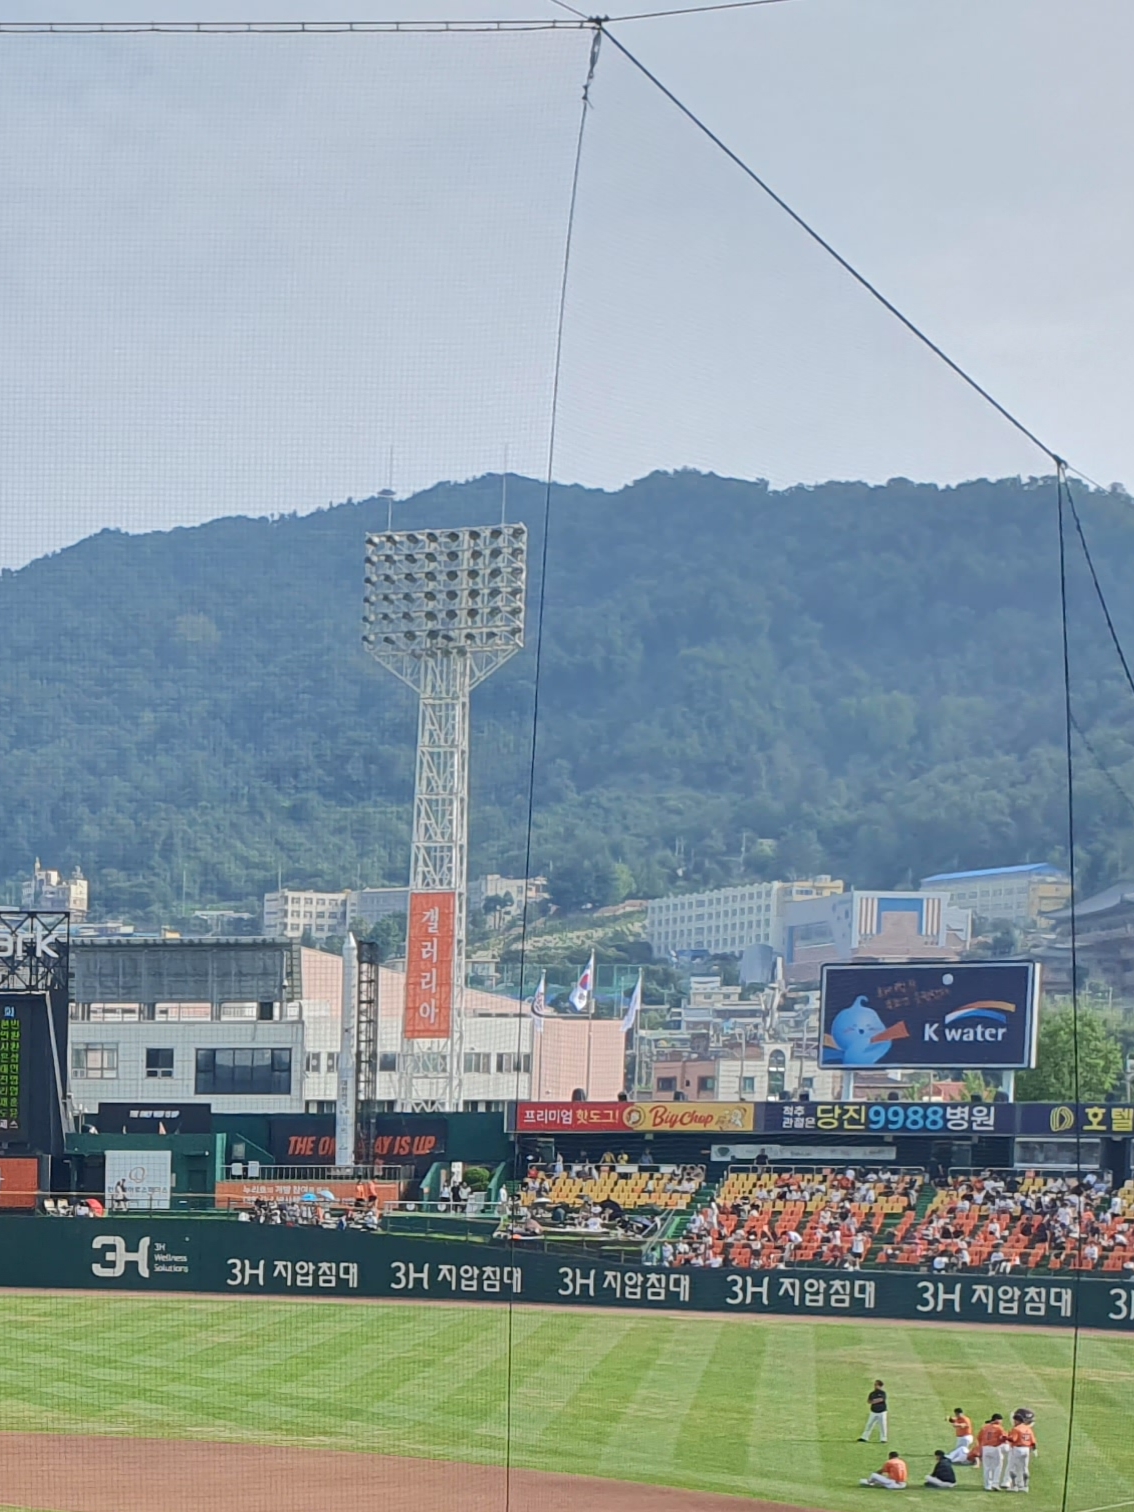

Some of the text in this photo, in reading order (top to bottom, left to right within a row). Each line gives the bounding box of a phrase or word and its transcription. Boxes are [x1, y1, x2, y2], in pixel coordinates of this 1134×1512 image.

[420, 905, 440, 1025] 갤러리아
[924, 1023, 1007, 1041] K water
[523, 1108, 619, 1125] 프리미엄 핫도그!
[782, 1105, 805, 1117] 척추
[288, 1136, 317, 1156] THE
[392, 1136, 412, 1156] IS
[412, 1135, 436, 1155] UP
[153, 1253, 188, 1262] Wellness
[153, 1263, 189, 1273] Solutions
[226, 1258, 359, 1288] 3H 지압침대
[390, 1261, 523, 1294] 3H 지압침대
[557, 1267, 691, 1302] 3H 지압침대
[725, 1274, 876, 1309] 3H 지압침대
[916, 1280, 1072, 1317] 3H 지압침대
[1108, 1288, 1134, 1320] 3
